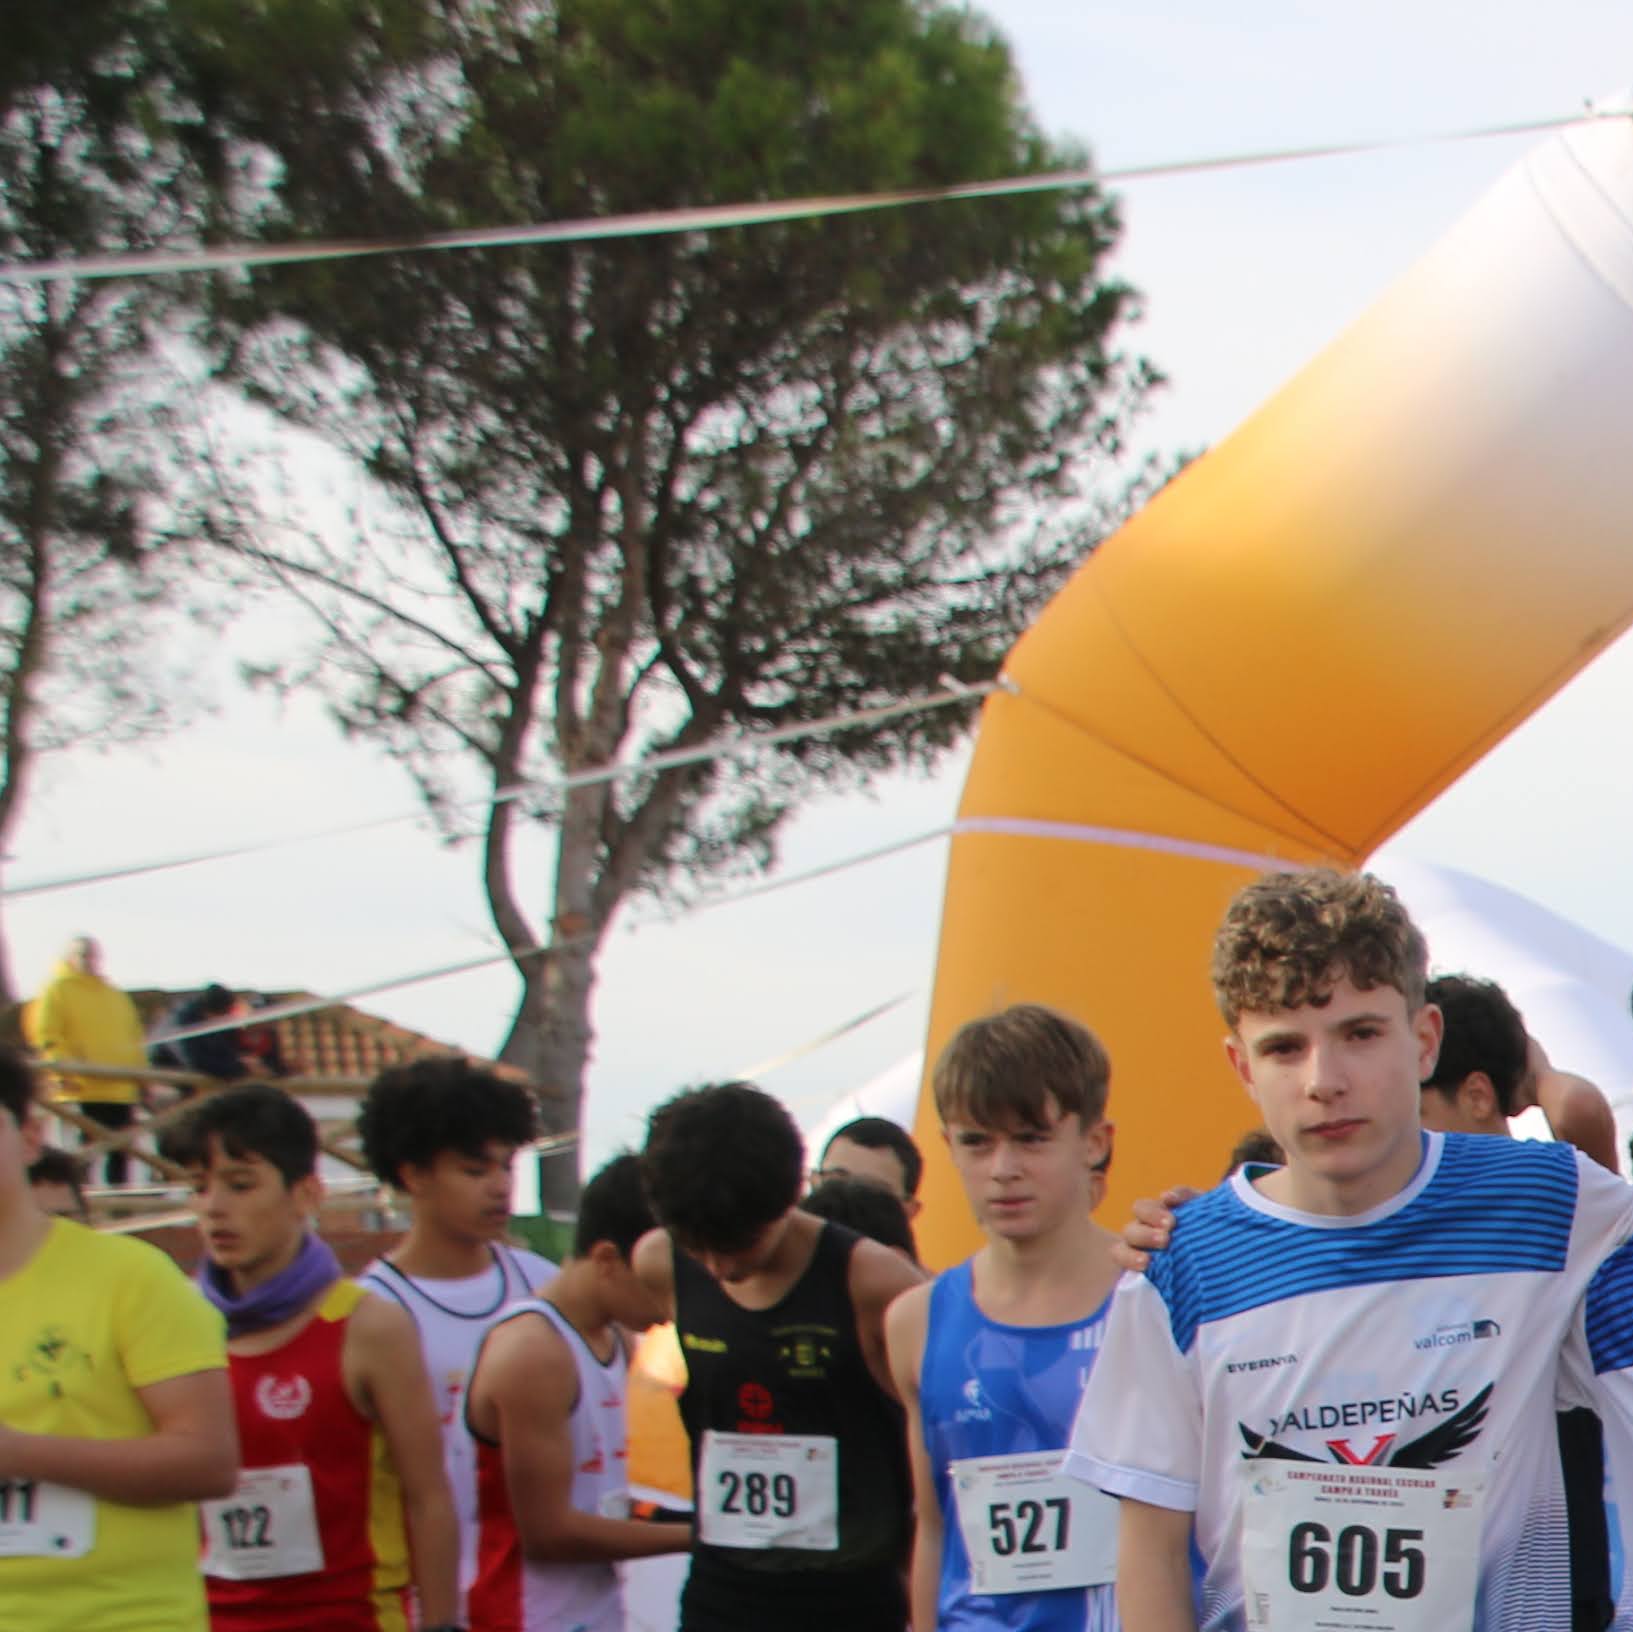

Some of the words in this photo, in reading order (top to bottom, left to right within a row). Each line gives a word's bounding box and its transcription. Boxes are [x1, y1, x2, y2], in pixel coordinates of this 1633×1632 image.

[1414, 1331, 1471, 1350] valcom
[718, 1470, 796, 1518] 289
[222, 1505, 275, 1549] 122
[989, 1497, 1071, 1556] 527
[1289, 1521, 1425, 1599] 605
